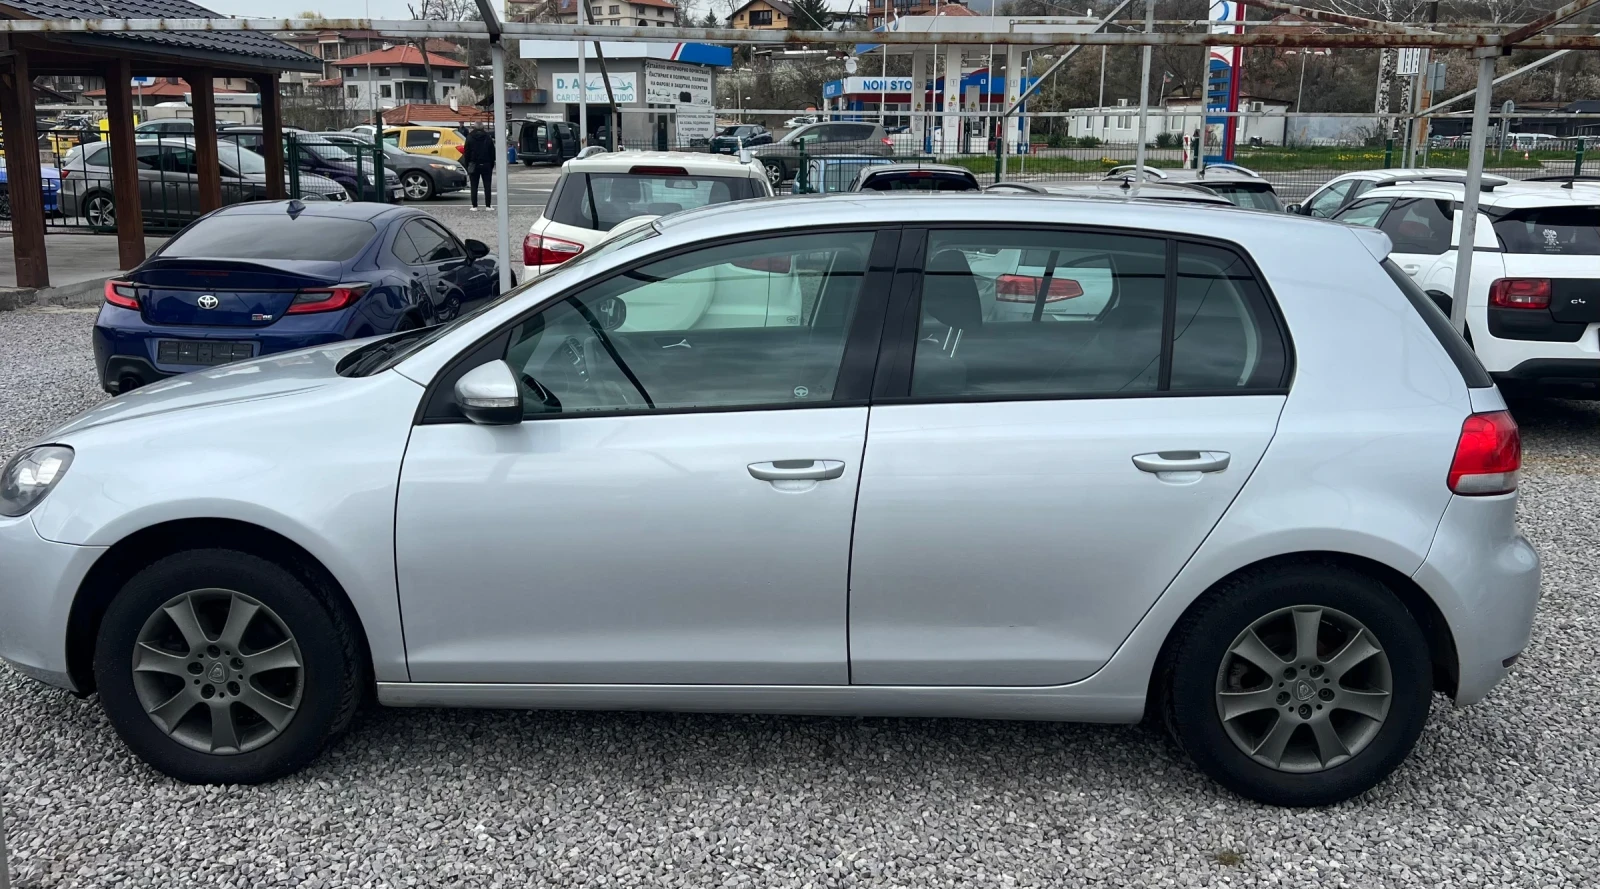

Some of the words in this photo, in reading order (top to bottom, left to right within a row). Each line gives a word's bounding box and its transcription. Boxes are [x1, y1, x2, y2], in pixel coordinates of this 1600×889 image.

[556, 78, 568, 89] D.
[863, 81, 887, 90] NON
[890, 81, 912, 90] STO
